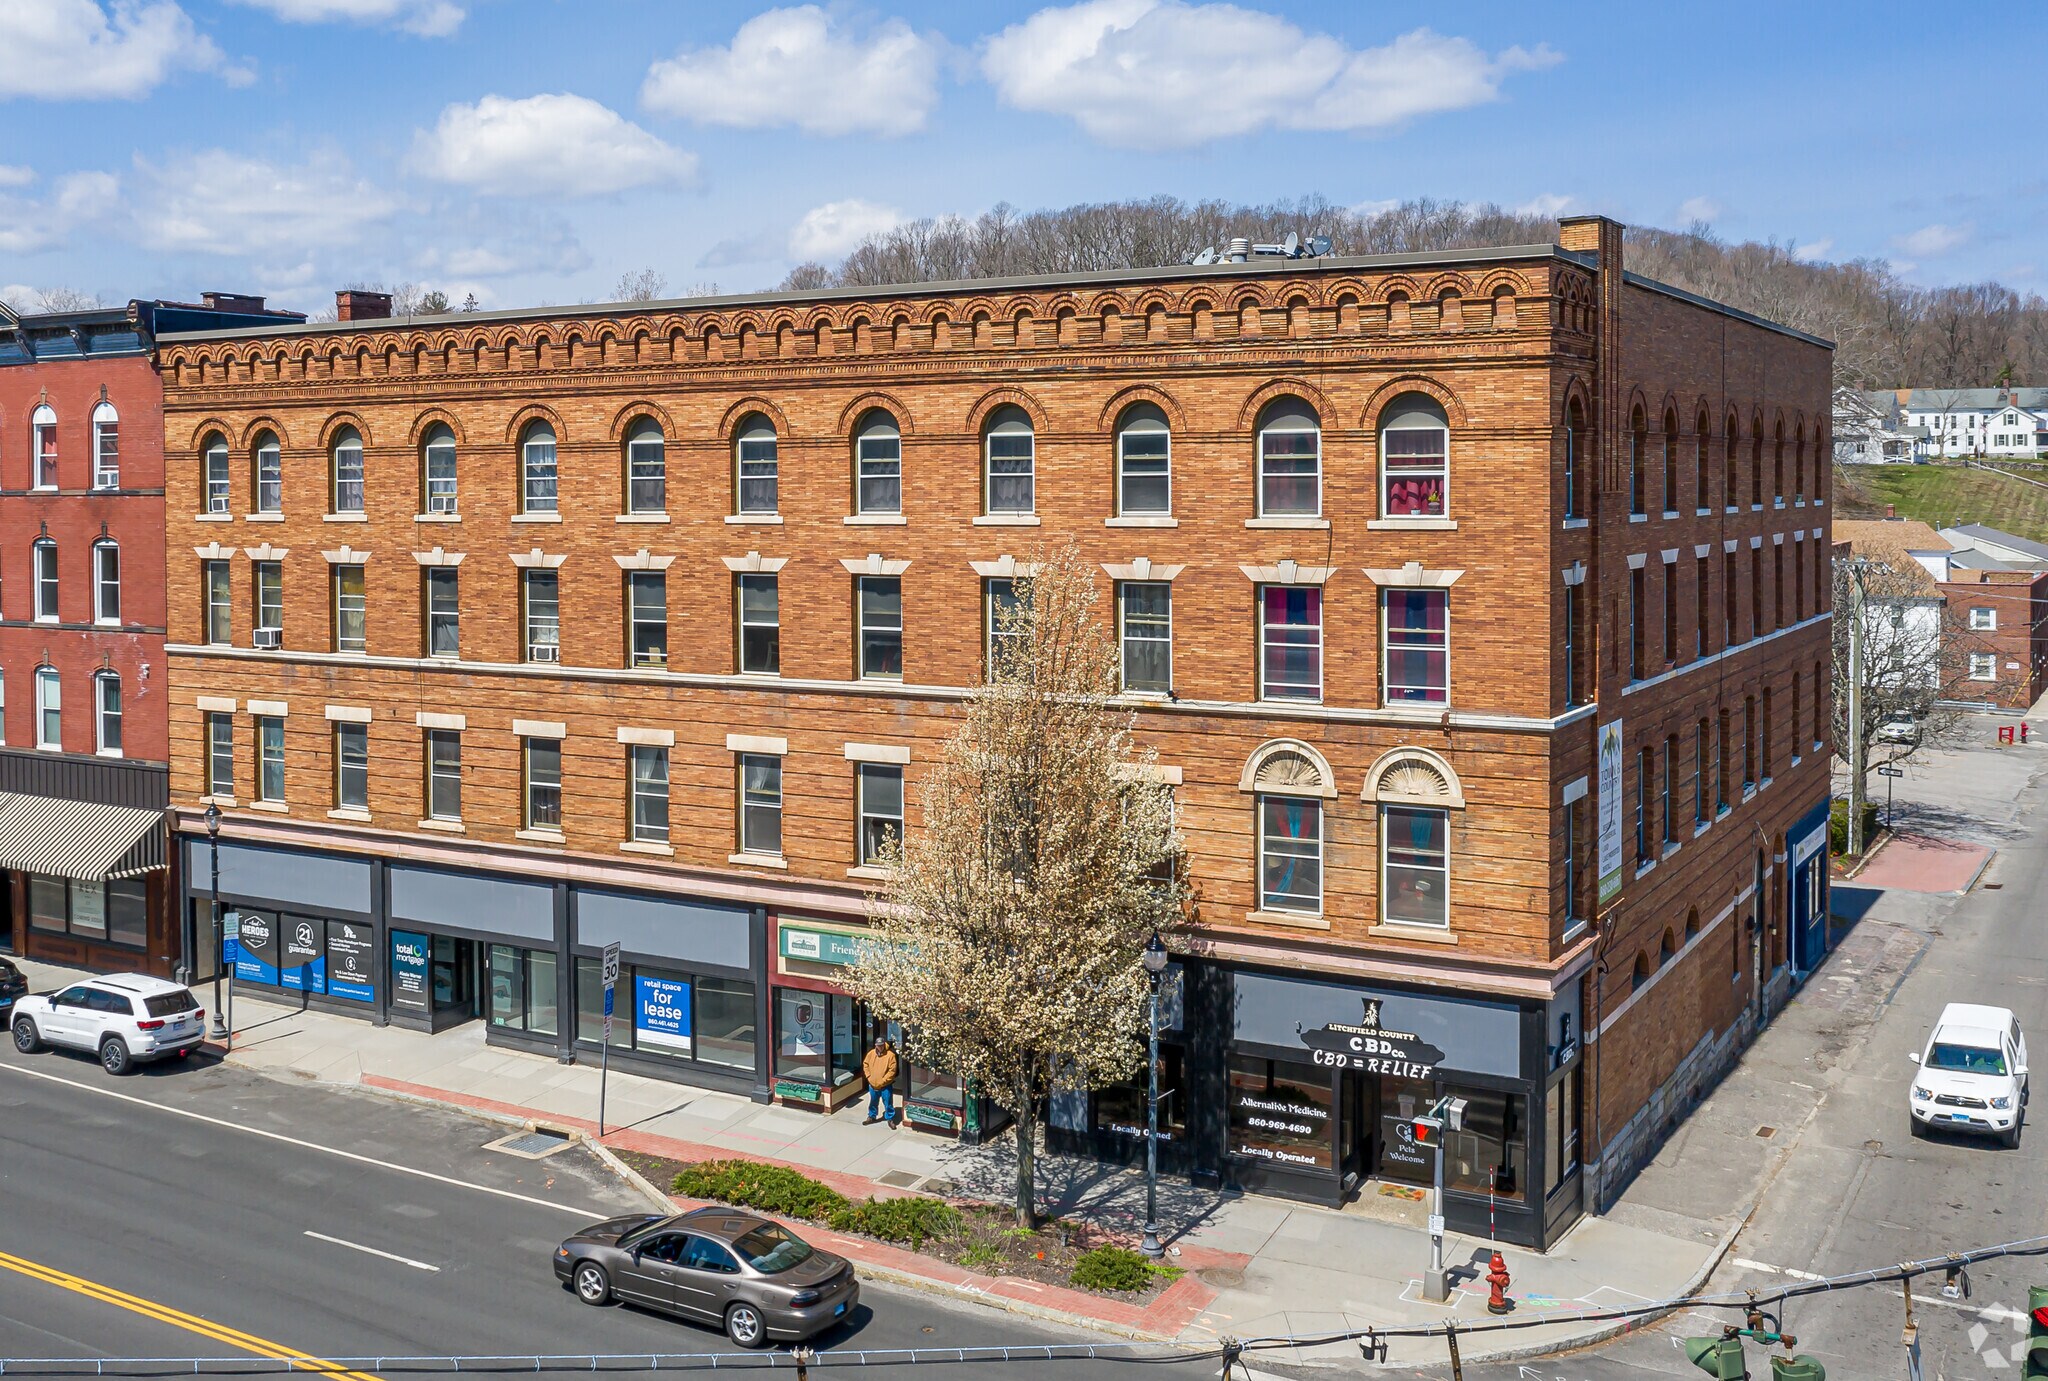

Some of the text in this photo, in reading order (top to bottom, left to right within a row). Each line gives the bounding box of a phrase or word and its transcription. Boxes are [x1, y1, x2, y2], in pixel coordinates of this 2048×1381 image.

[79, 883, 97, 895] REX
[241, 924, 270, 937] HEROES
[299, 927, 311, 941] 21
[288, 945, 316, 956] guarantee
[396, 944, 413, 955] total
[605, 947, 619, 957] SPEED
[831, 943, 864, 956] Friend
[396, 954, 425, 967] mortgage
[606, 955, 617, 964] LIMIT
[604, 963, 617, 980] 30
[644, 980, 682, 992] retail space
[653, 989, 673, 1005] for
[644, 1000, 682, 1020] lease
[648, 1018, 680, 1028] 860.461.4625
[1328, 1023, 1416, 1041] LITCHFIELD COUNTY
[1349, 1036, 1392, 1055] CBD
[1313, 1049, 1347, 1068] CBD
[1367, 1058, 1433, 1080] RELIEF
[1240, 1097, 1327, 1119] Alternative Medicine
[1111, 1123, 1171, 1140] Locally Oned
[1248, 1117, 1312, 1134] 860-969-4690
[1241, 1145, 1316, 1165] Locally Operated
[1398, 1144, 1416, 1154] Pets
[1389, 1152, 1426, 1164] Welcome
